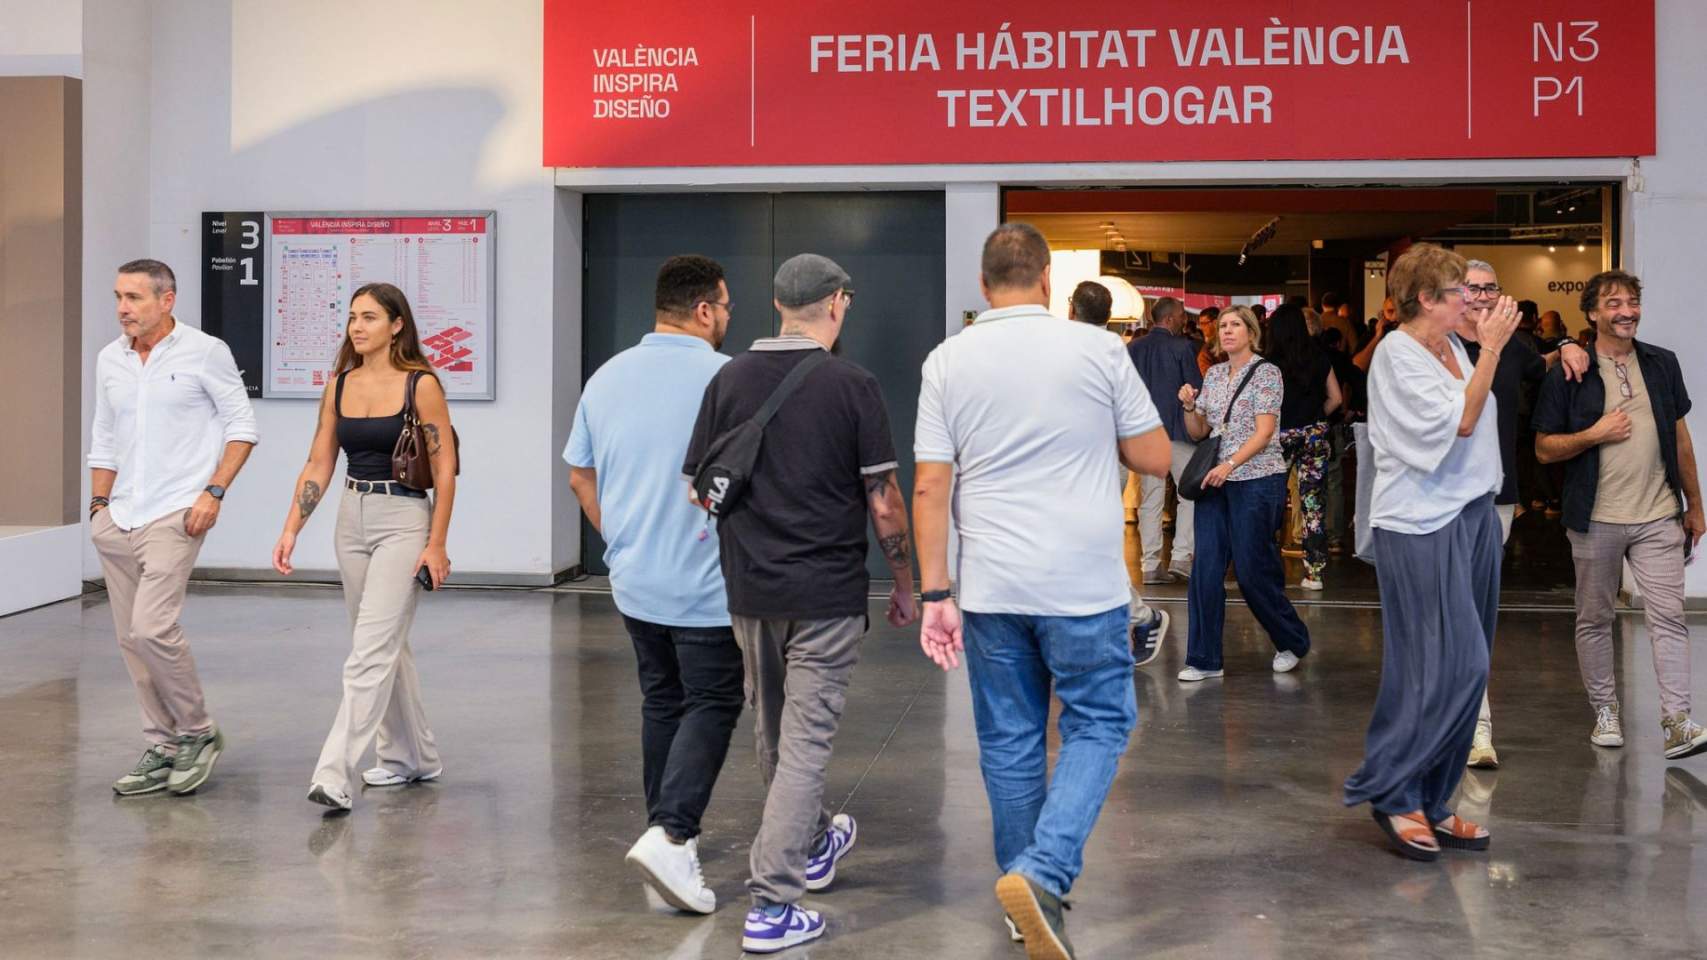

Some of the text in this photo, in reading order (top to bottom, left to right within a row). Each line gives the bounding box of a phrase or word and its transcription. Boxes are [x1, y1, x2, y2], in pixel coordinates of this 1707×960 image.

[810, 17, 1410, 73] FERIA HÁBITAT VALÈNCIA
[1533, 21, 1599, 62] N3
[592, 44, 699, 68] VALÈNCIA
[593, 73, 679, 94] INSPIRA
[1534, 76, 1583, 117] P1
[592, 95, 670, 119] DISEÑO
[937, 86, 1273, 128] TEXTILHOGAR
[241, 221, 260, 249] 3
[442, 218, 451, 231] 3
[470, 218, 477, 231] 1
[240, 257, 258, 285] 1
[704, 476, 730, 513] FILA
